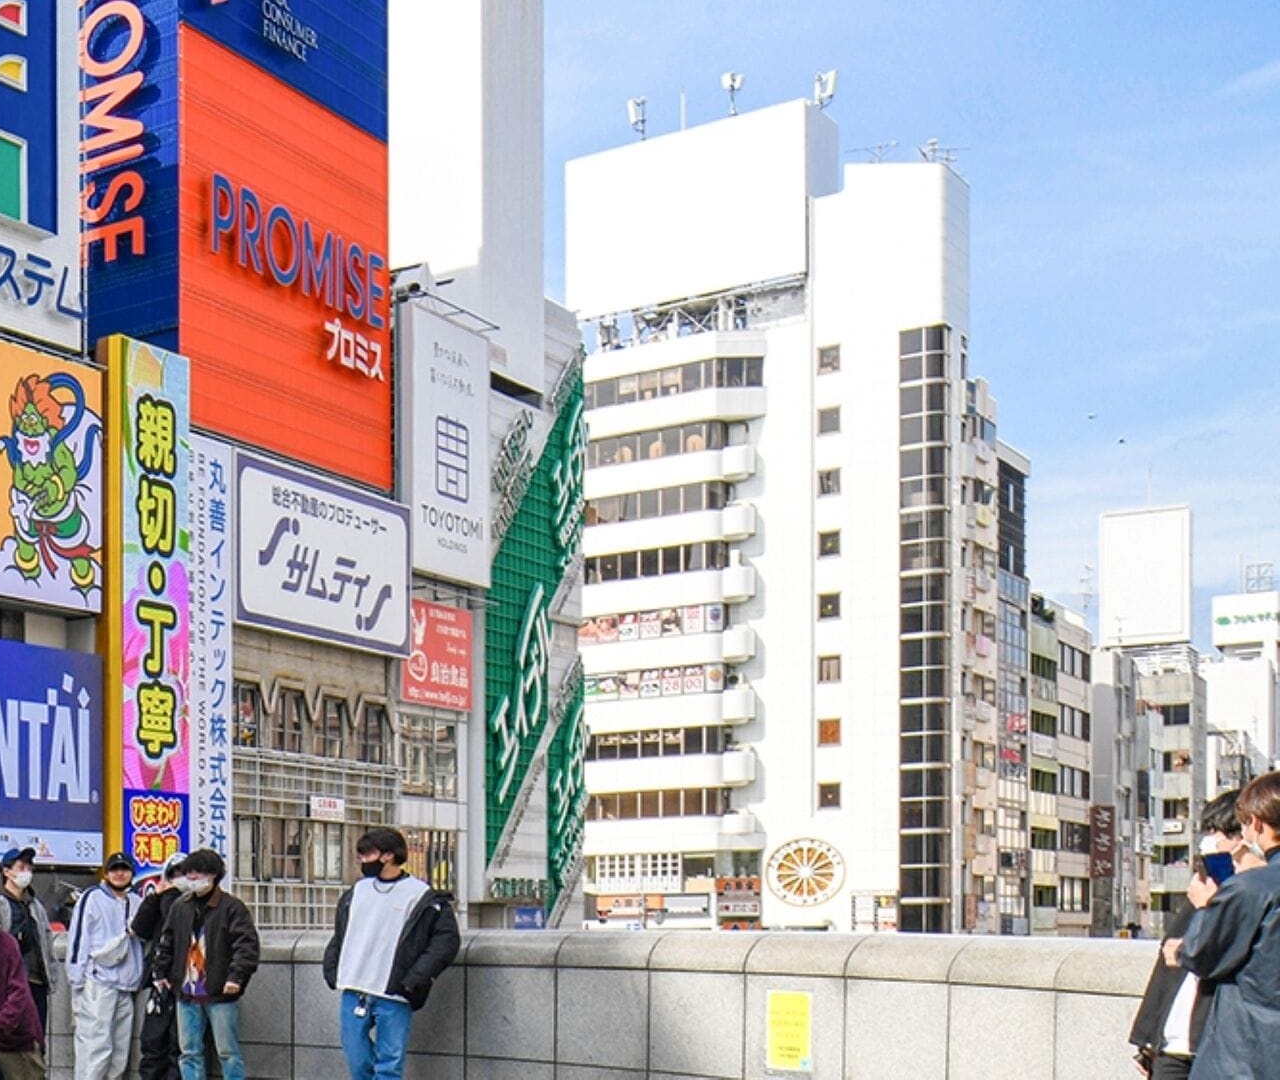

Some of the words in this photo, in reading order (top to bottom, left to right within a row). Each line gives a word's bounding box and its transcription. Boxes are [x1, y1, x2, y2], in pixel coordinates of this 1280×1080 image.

[261, 0, 318, 50] CONSUMER
[262, 21, 308, 63] FINANCE
[211, 171, 385, 329] PROMISE
[323, 317, 385, 382] プロミス
[420, 503, 484, 541] TOYOTOMI
[281, 542, 371, 609] サムティ
[131, 797, 182, 830] ひまわり
